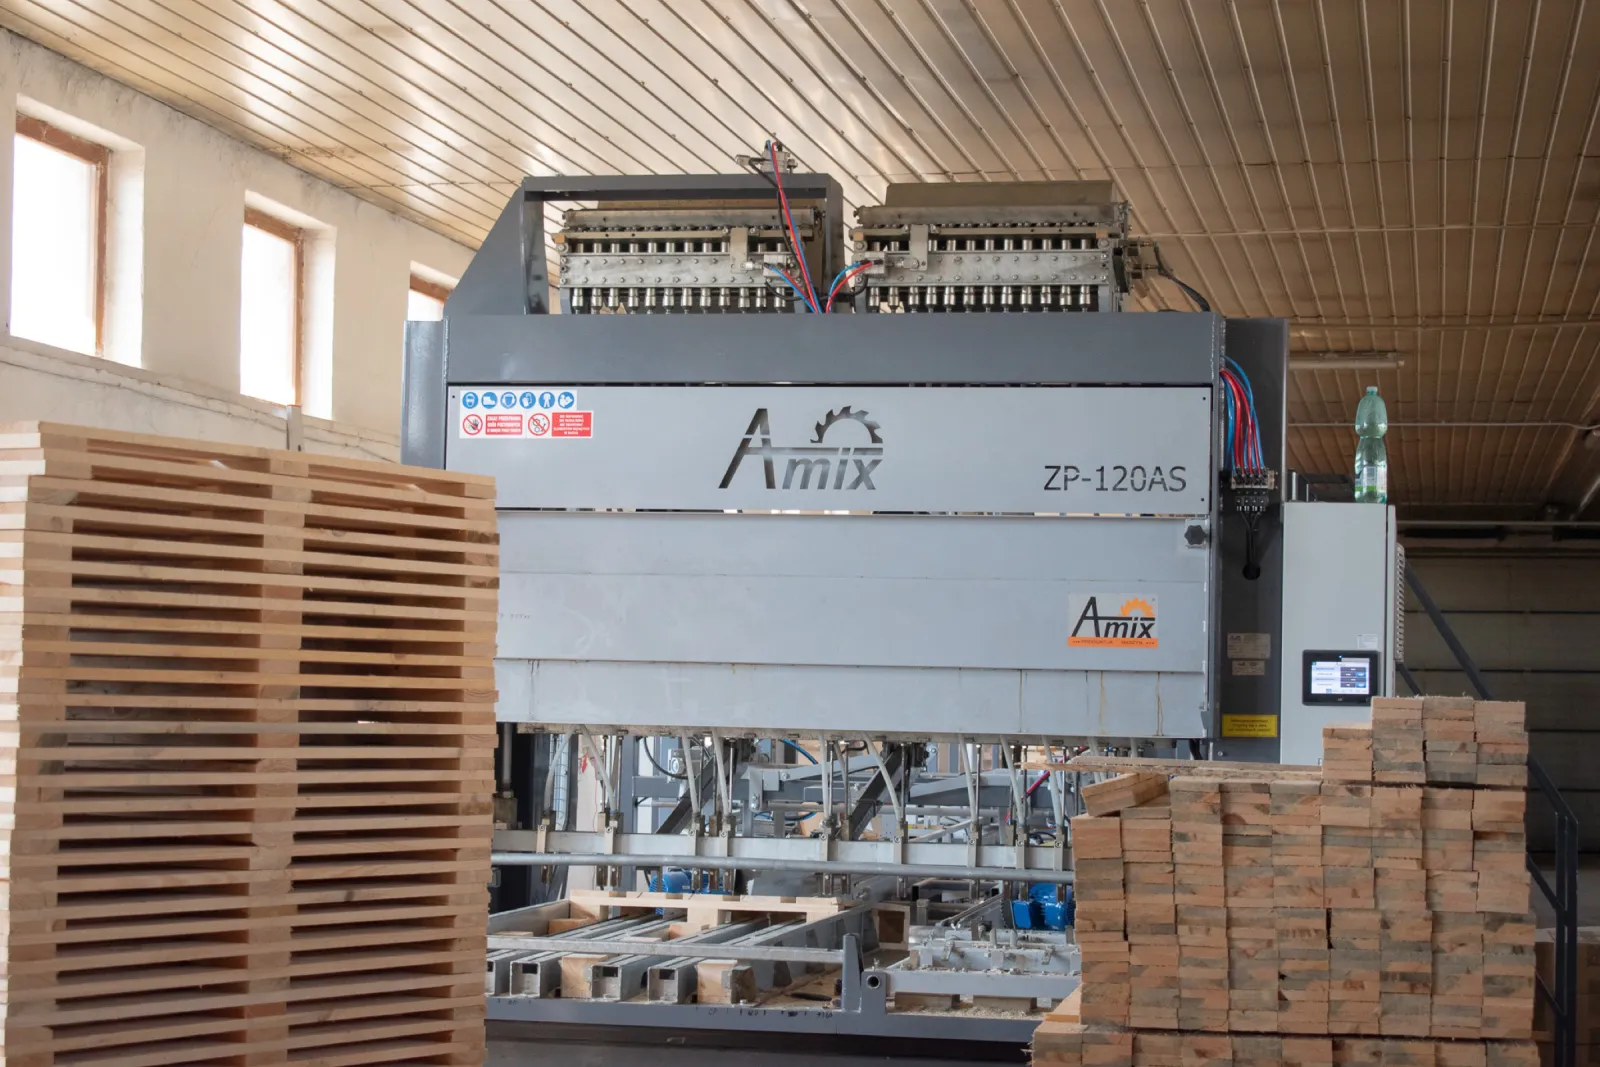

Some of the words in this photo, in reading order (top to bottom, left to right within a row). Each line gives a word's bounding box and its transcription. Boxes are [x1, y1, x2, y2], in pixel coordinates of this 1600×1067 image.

[718, 407, 884, 491] Amix
[1044, 465, 1187, 492] ZP-120AS
[1071, 596, 1156, 639] Amix
